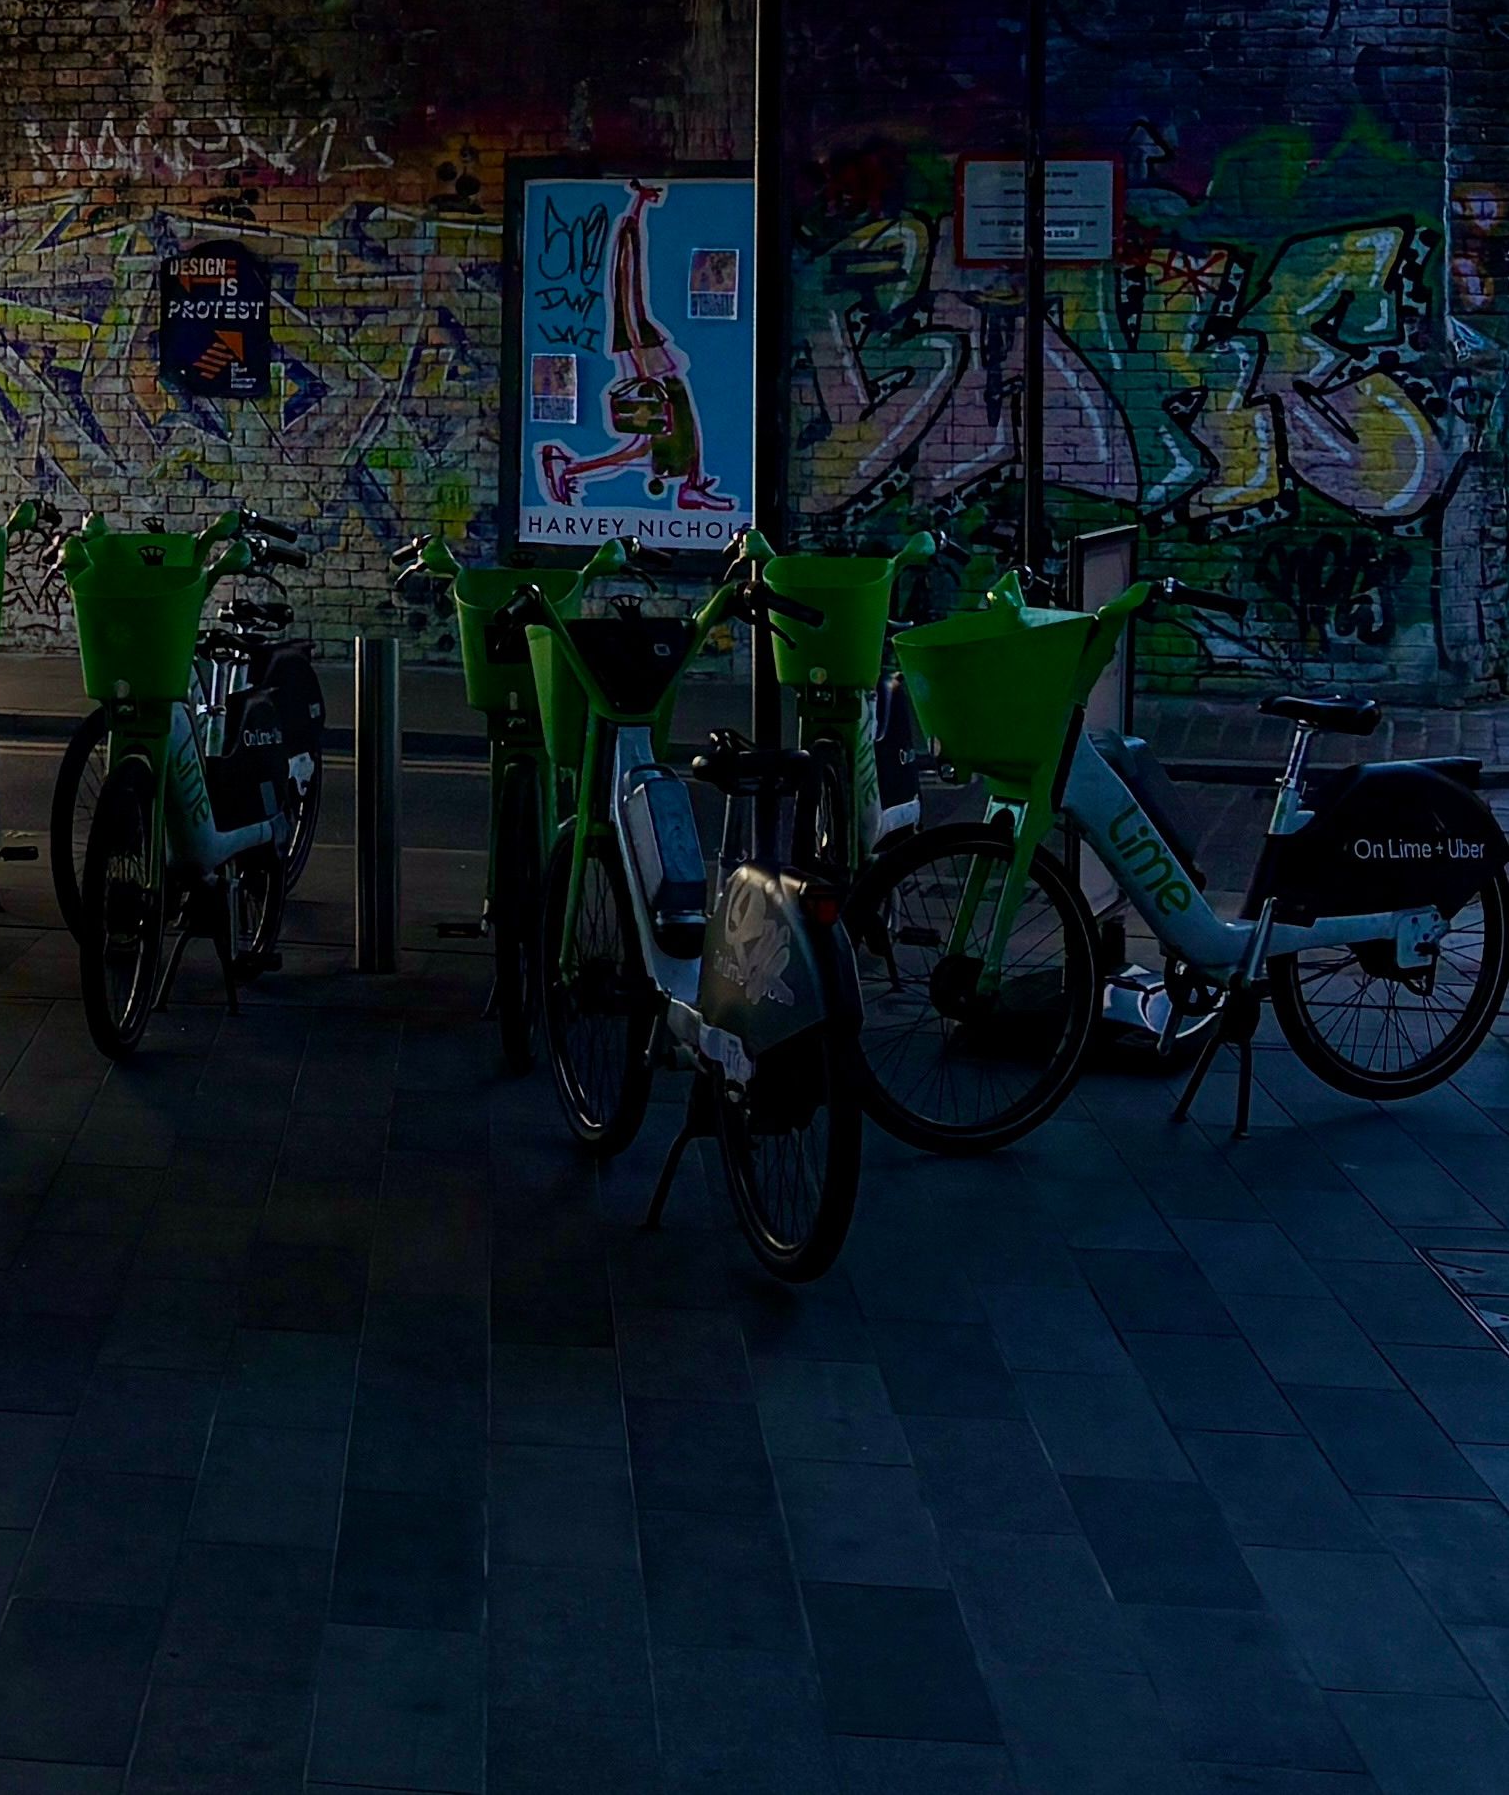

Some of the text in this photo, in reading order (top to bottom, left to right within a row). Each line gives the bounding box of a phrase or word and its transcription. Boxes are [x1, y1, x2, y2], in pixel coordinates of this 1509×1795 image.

[169, 258, 226, 276] DESIGN
[220, 277, 239, 296] IS
[167, 300, 264, 319] PROTEST
[528, 515, 624, 536] HARVEY
[1354, 838, 1384, 859] On
[1388, 838, 1432, 859] Lime
[1447, 838, 1486, 859] Uber
[1108, 805, 1192, 917] Lime
